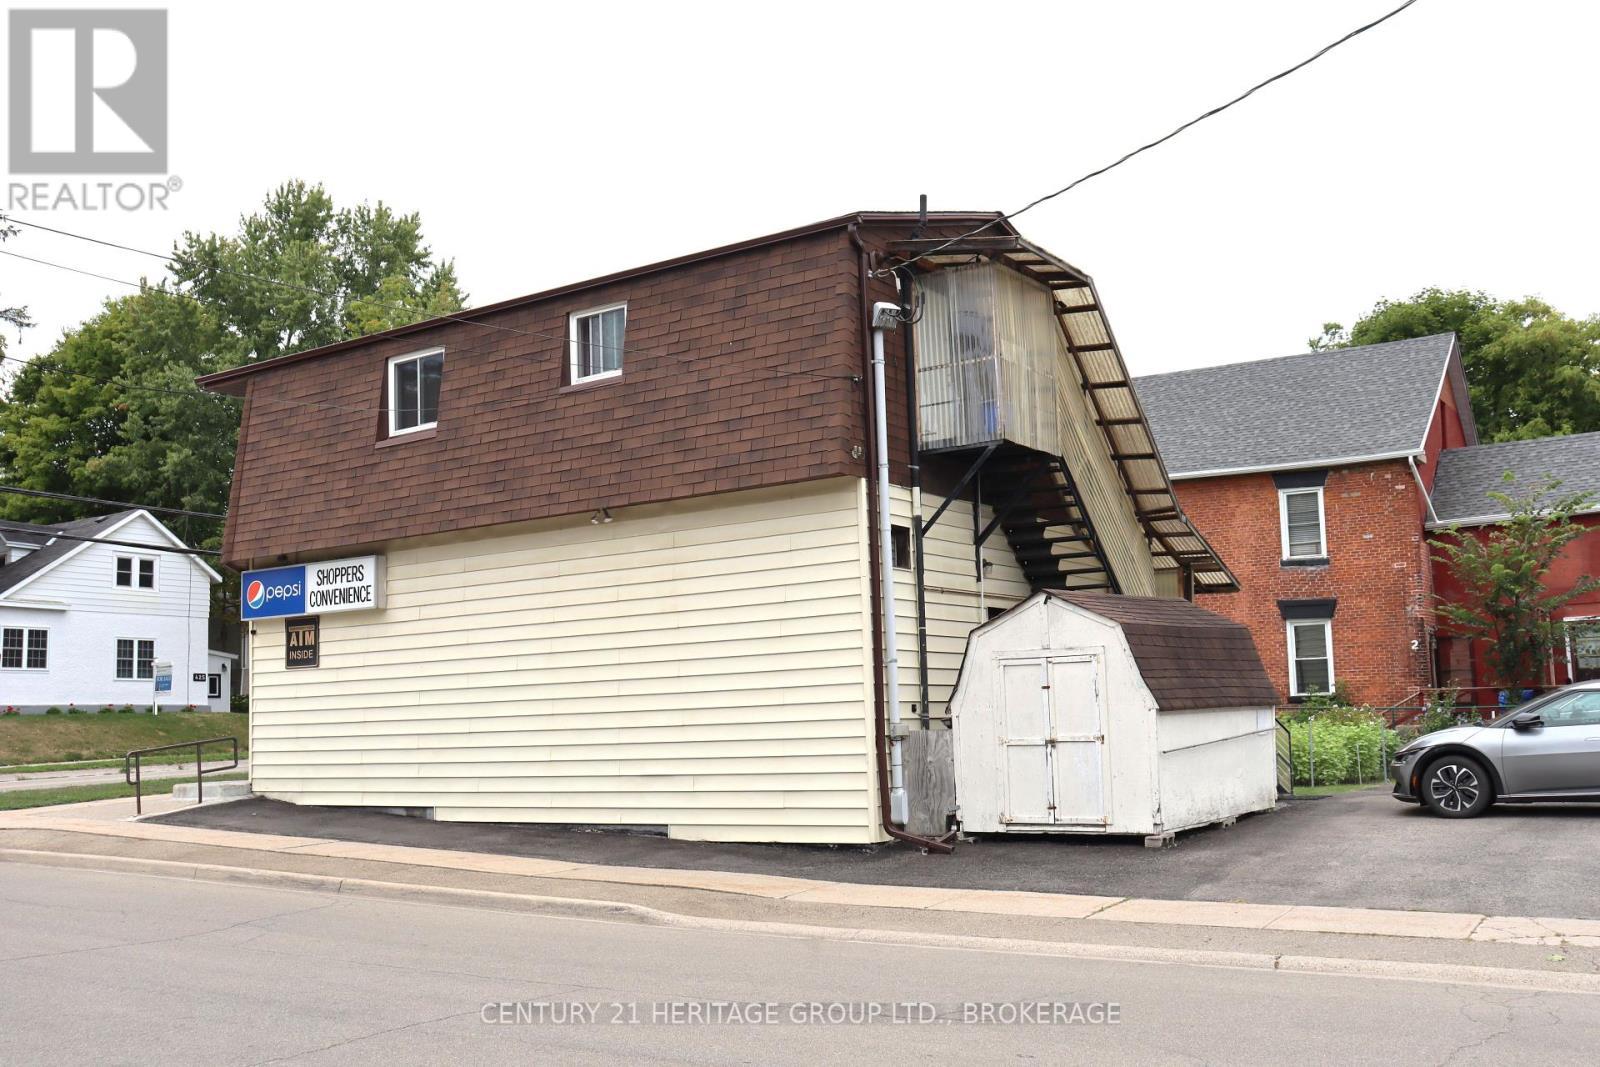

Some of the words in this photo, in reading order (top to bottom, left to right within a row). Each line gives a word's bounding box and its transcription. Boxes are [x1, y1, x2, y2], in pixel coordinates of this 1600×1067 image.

[316, 564, 364, 586] SHOPPERS
[266, 581, 301, 602] pepsi
[309, 585, 372, 607] CONVENIENCE
[289, 626, 315, 647] ATM
[1411, 639, 1419, 650] 2
[289, 650, 314, 660] INSIDE
